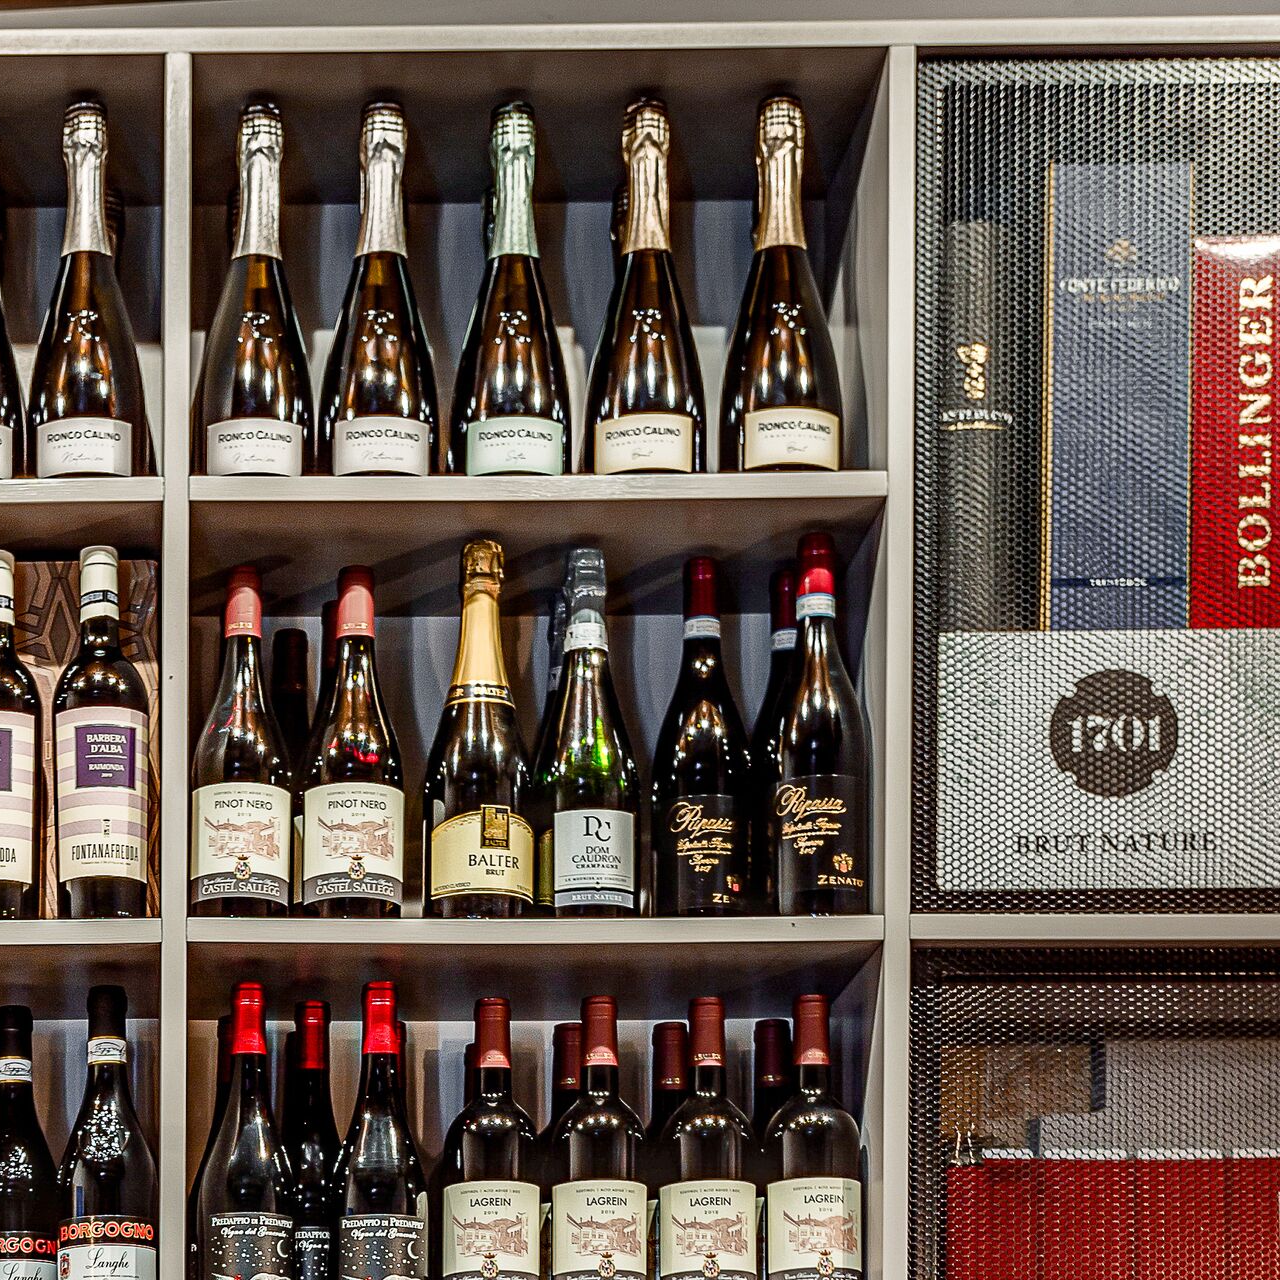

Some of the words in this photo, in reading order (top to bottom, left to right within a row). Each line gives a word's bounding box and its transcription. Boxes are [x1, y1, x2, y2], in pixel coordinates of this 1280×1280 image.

[758, 421, 797, 433] RONCO
[1237, 275, 1274, 589] BOLLINGER
[346, 429, 383, 441] RONCO
[1069, 713, 1162, 752] 1701
[86, 734, 127, 744] BARBERA
[90, 744, 123, 754] D'ALBA
[215, 799, 243, 809] PINOT
[247, 800, 273, 810] NERO
[328, 799, 357, 809] PINOT
[360, 800, 387, 810] NERO
[1016, 833, 1094, 853] BRUT
[1102, 832, 1219, 851] NATURE
[71, 843, 139, 862] FONTANAFREDDA
[585, 846, 610, 854] DOM
[468, 854, 520, 869] BALTER
[572, 854, 621, 864] CAUDRON
[817, 875, 864, 887] ZENATO
[202, 882, 237, 895] CASTEL
[239, 883, 280, 896] SALLEGG
[316, 882, 351, 895] CASTEL
[354, 883, 394, 896] SALLEGG
[470, 1197, 511, 1208] LAGREIN
